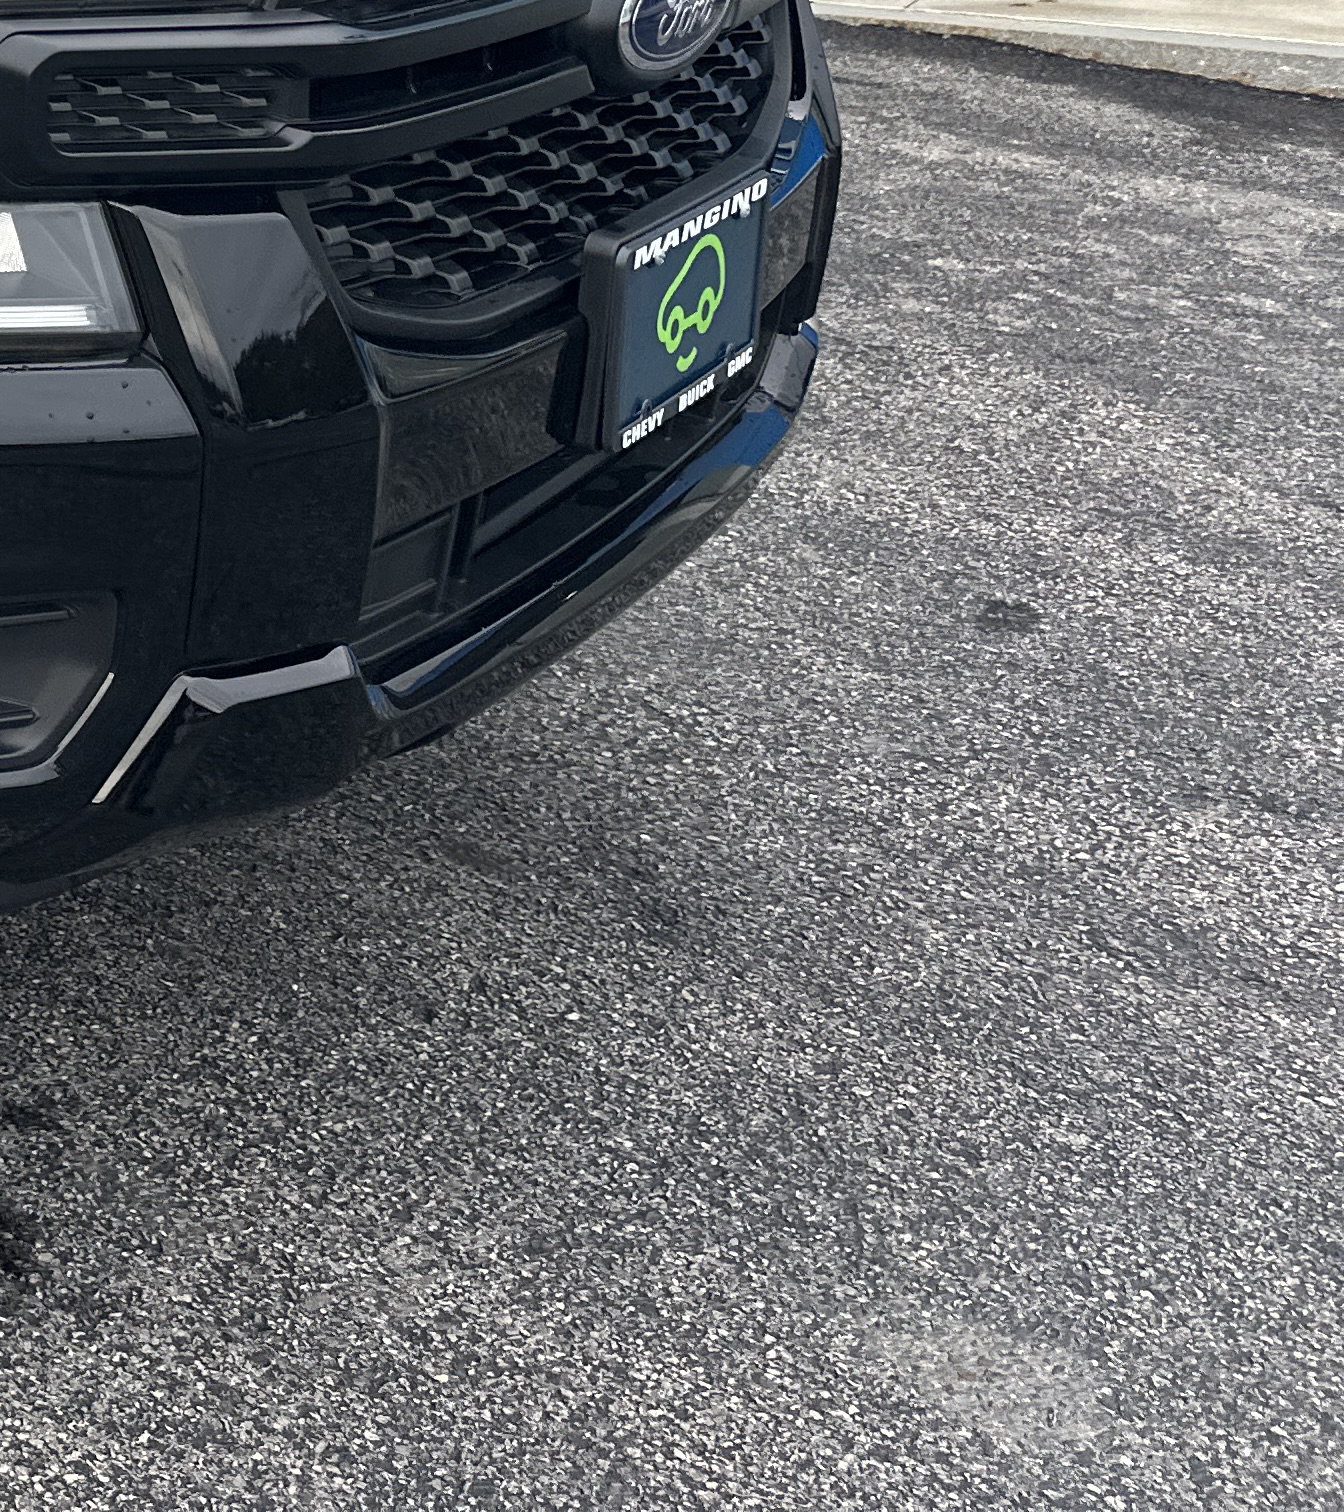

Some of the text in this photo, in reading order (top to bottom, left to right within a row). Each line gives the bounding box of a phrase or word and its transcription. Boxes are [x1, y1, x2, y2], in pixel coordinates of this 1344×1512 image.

[633, 177, 768, 271] MANGINO
[622, 346, 753, 449] CHEVY BUICK GMC
